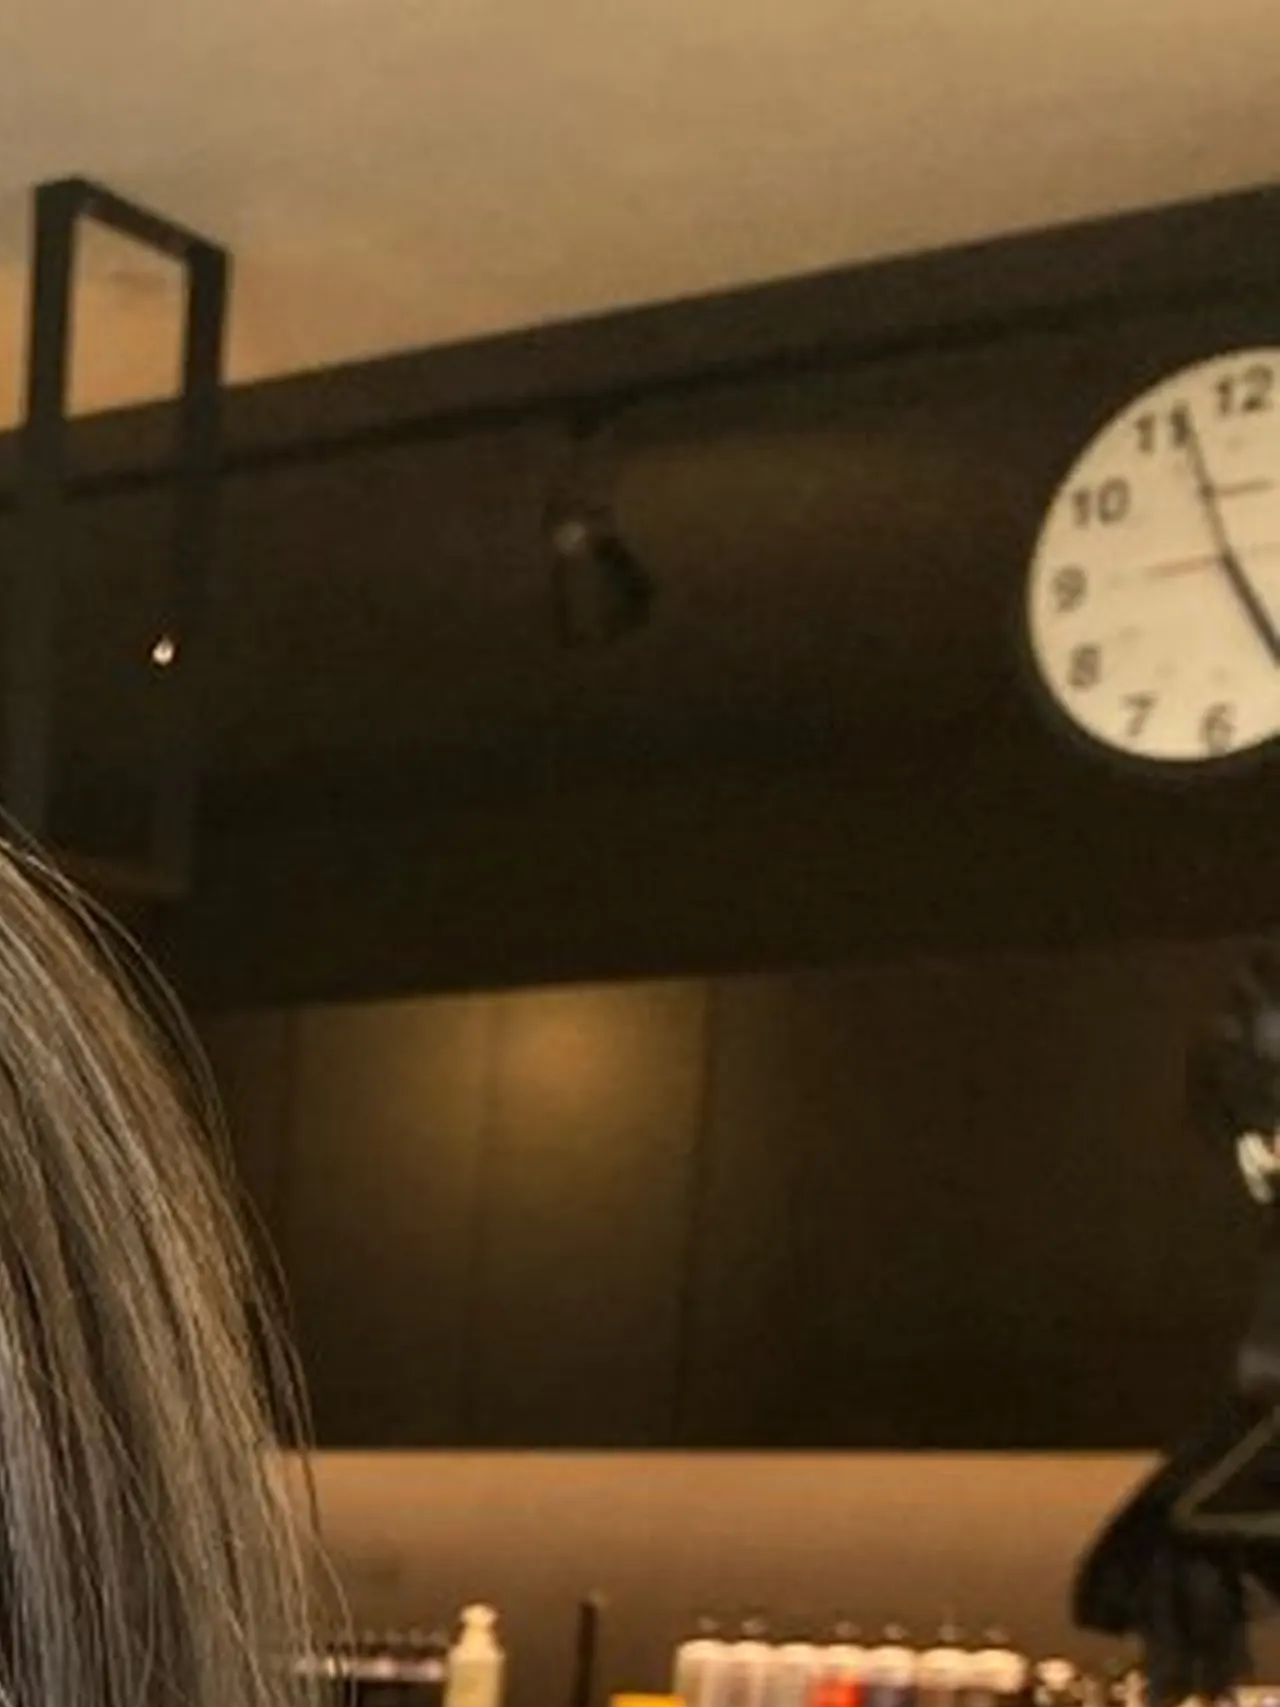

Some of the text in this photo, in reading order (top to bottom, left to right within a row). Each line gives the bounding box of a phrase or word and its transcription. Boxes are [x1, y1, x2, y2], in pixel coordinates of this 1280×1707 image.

[1217, 363, 1274, 415] 12
[1134, 404, 1191, 454] 11
[1072, 476, 1131, 528] 10
[1051, 564, 1088, 613] 9
[1067, 642, 1102, 690] 8
[1120, 693, 1157, 738] 7
[1200, 702, 1238, 756] 6
